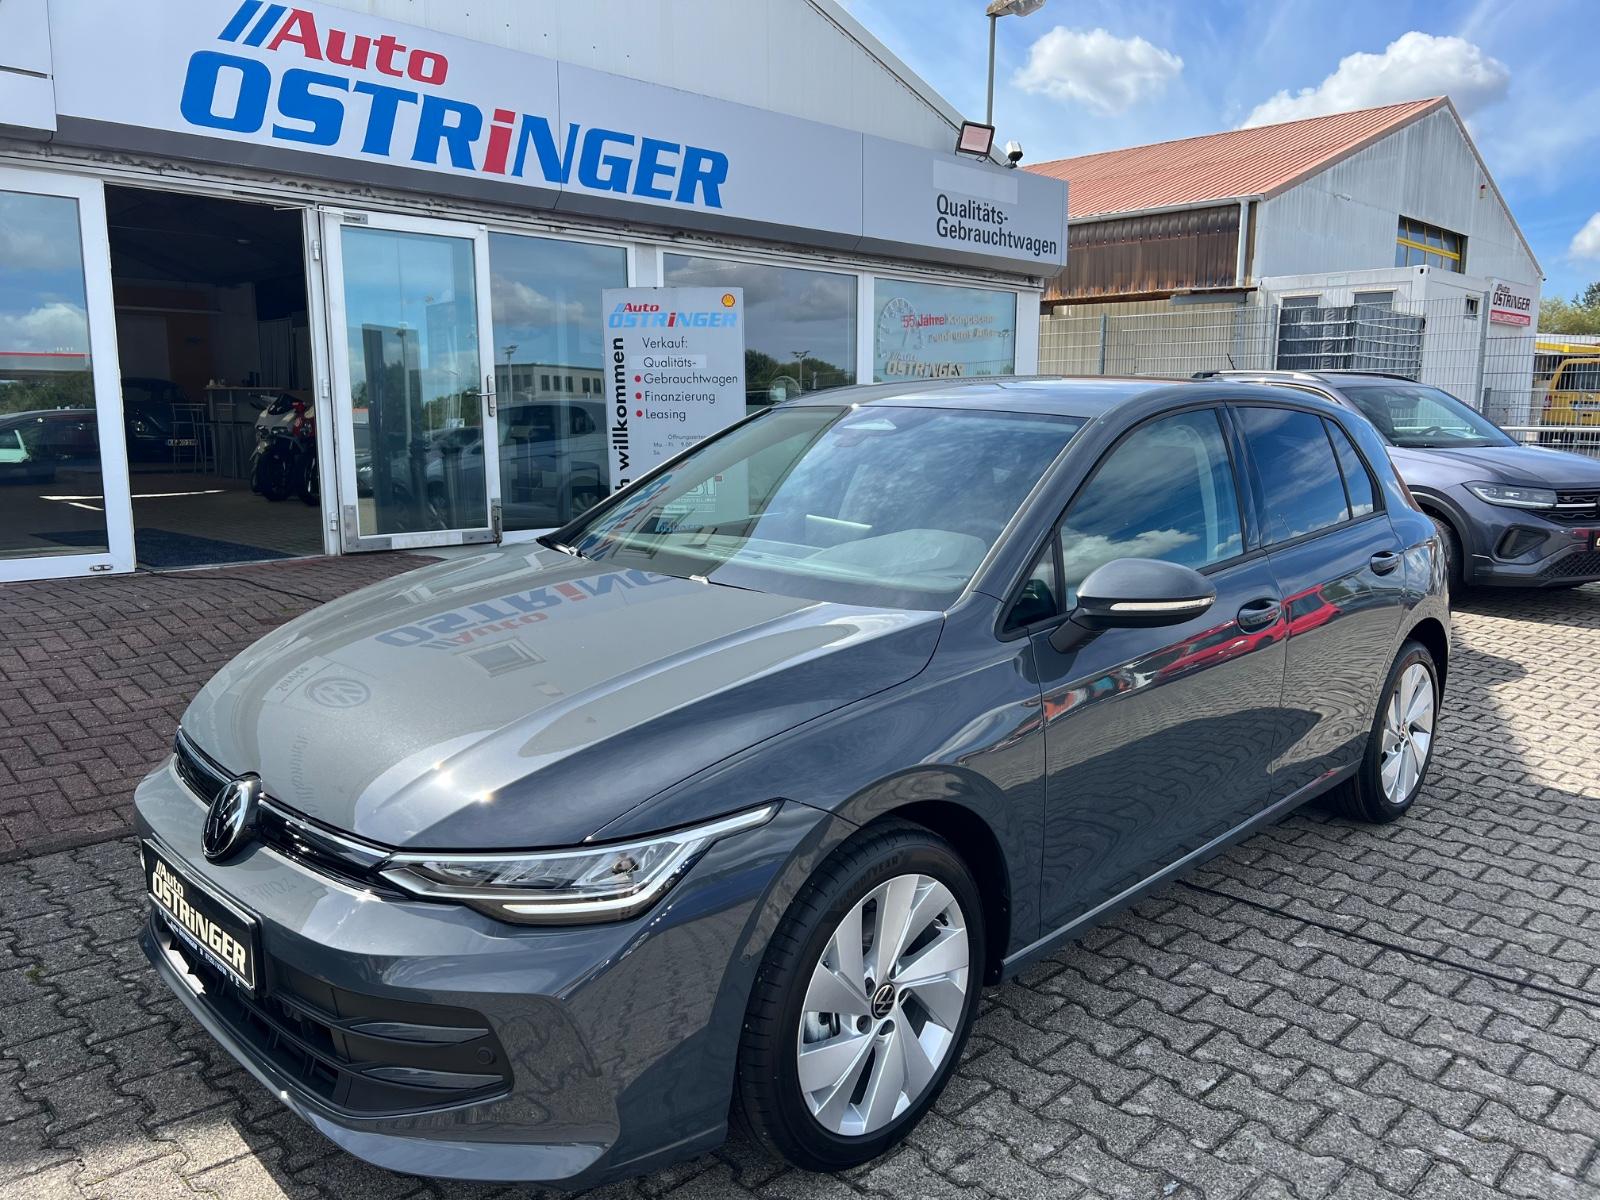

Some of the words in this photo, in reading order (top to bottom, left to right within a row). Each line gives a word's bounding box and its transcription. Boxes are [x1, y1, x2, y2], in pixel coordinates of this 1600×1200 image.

[936, 193, 1009, 225] Qualitäts-
[936, 216, 1057, 257] Gebrauchtwagen
[642, 336, 688, 349] Verkauf:
[643, 356, 697, 368] Qualitäts-
[643, 373, 738, 387] Gebrauchtwagen
[612, 337, 630, 471] willkommen
[644, 391, 716, 404] Finanzierung
[645, 409, 687, 422] Leasing
